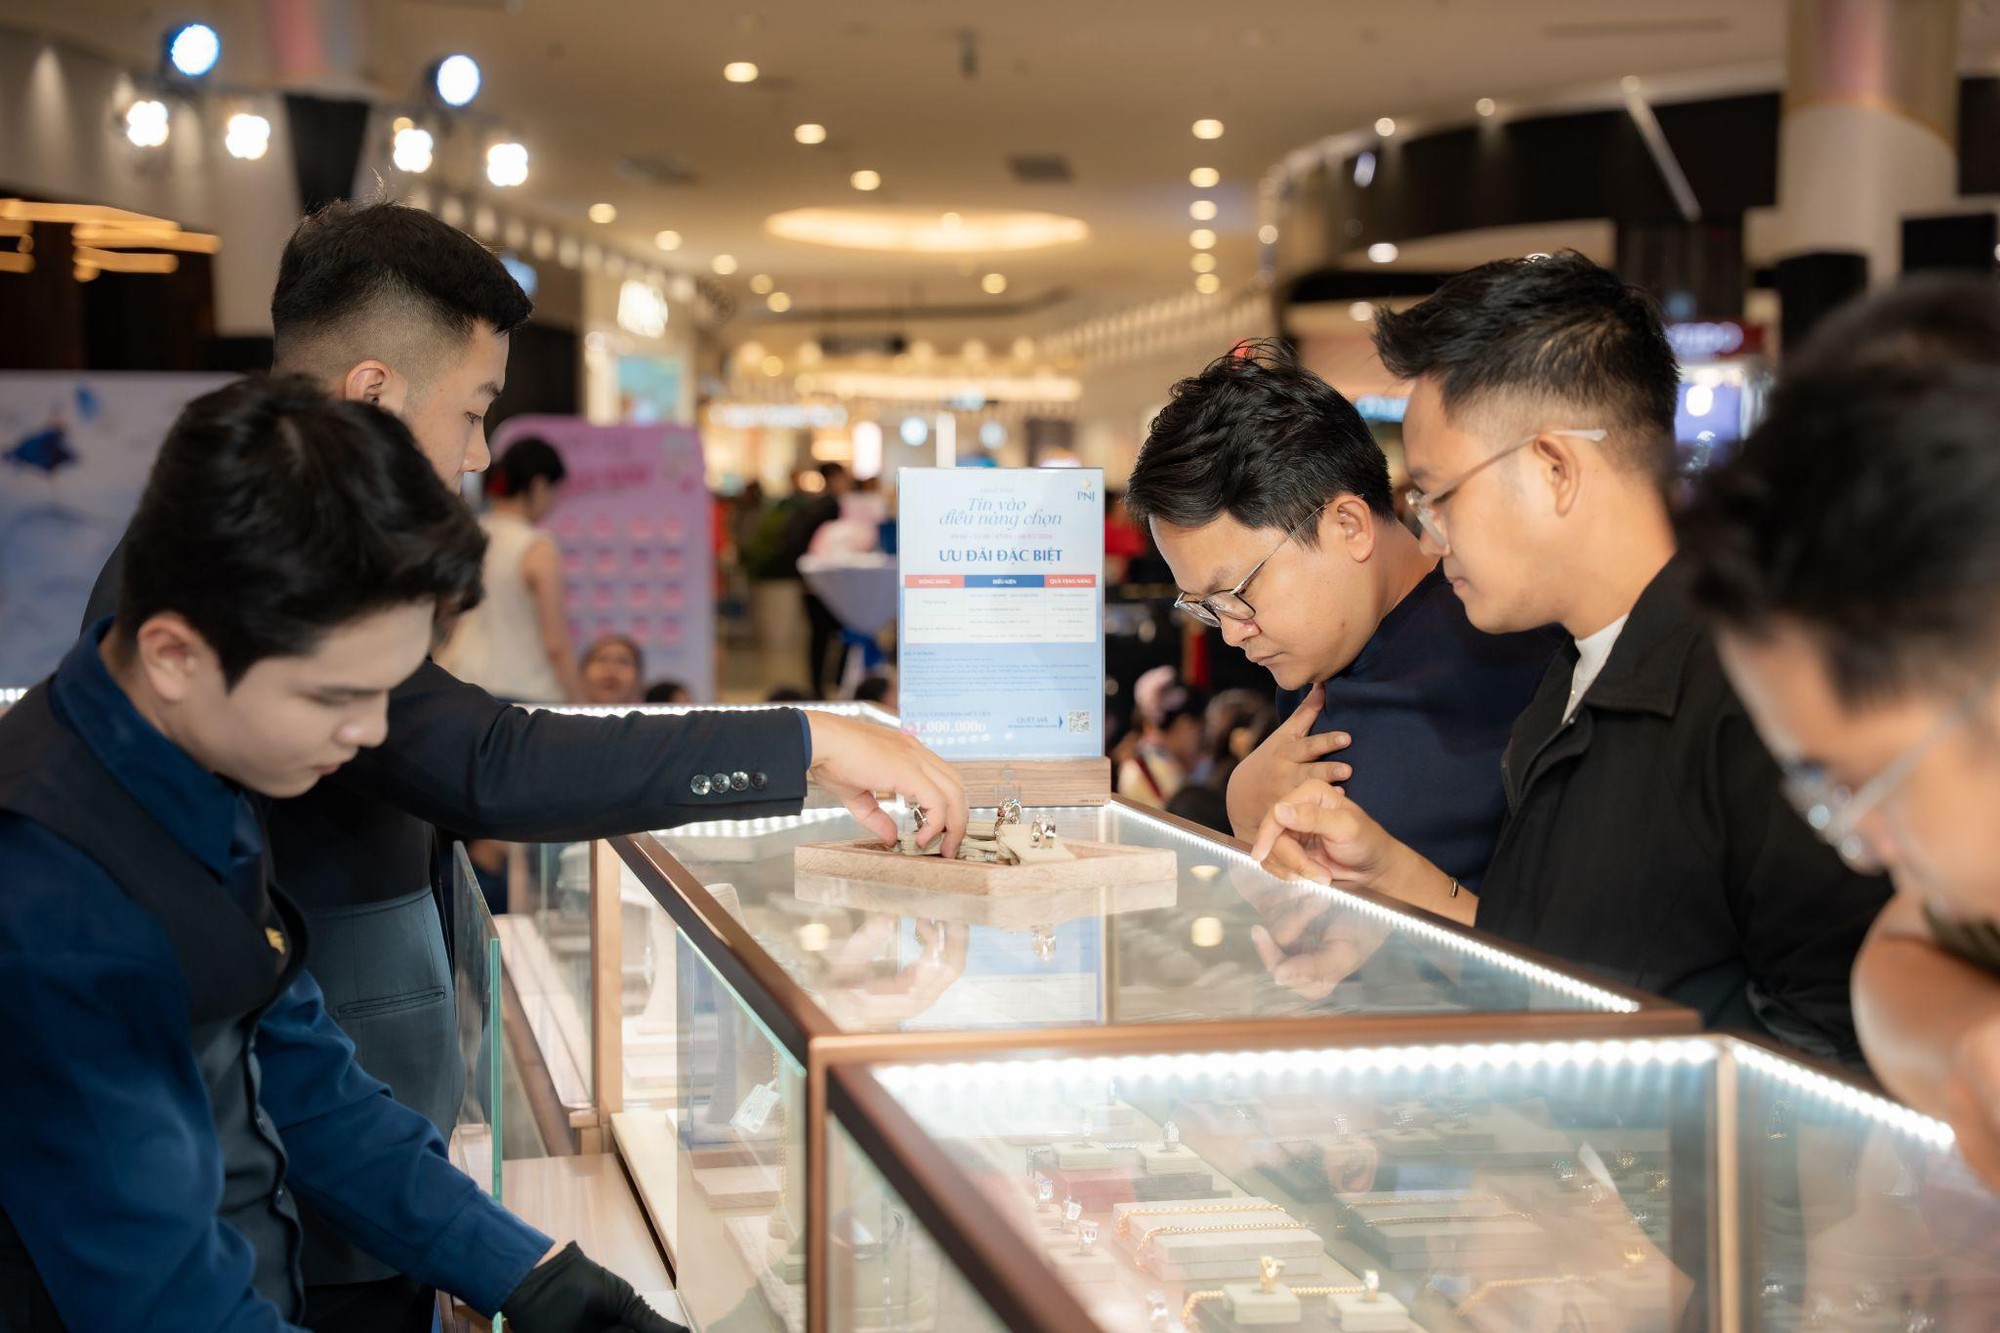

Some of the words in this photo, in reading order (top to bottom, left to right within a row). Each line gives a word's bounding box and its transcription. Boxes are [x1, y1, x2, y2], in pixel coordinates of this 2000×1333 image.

[1077, 491, 1095, 502] PNJ
[968, 498, 993, 511] Tin
[999, 498, 1027, 511] vào
[939, 509, 973, 526] điều
[978, 511, 1019, 530] nàng
[1024, 508, 1062, 528] chọn
[939, 548, 962, 562] ƯU
[966, 547, 992, 562] ĐÃI
[997, 547, 1029, 564] ĐẶC
[1033, 547, 1062, 564] BIỆT
